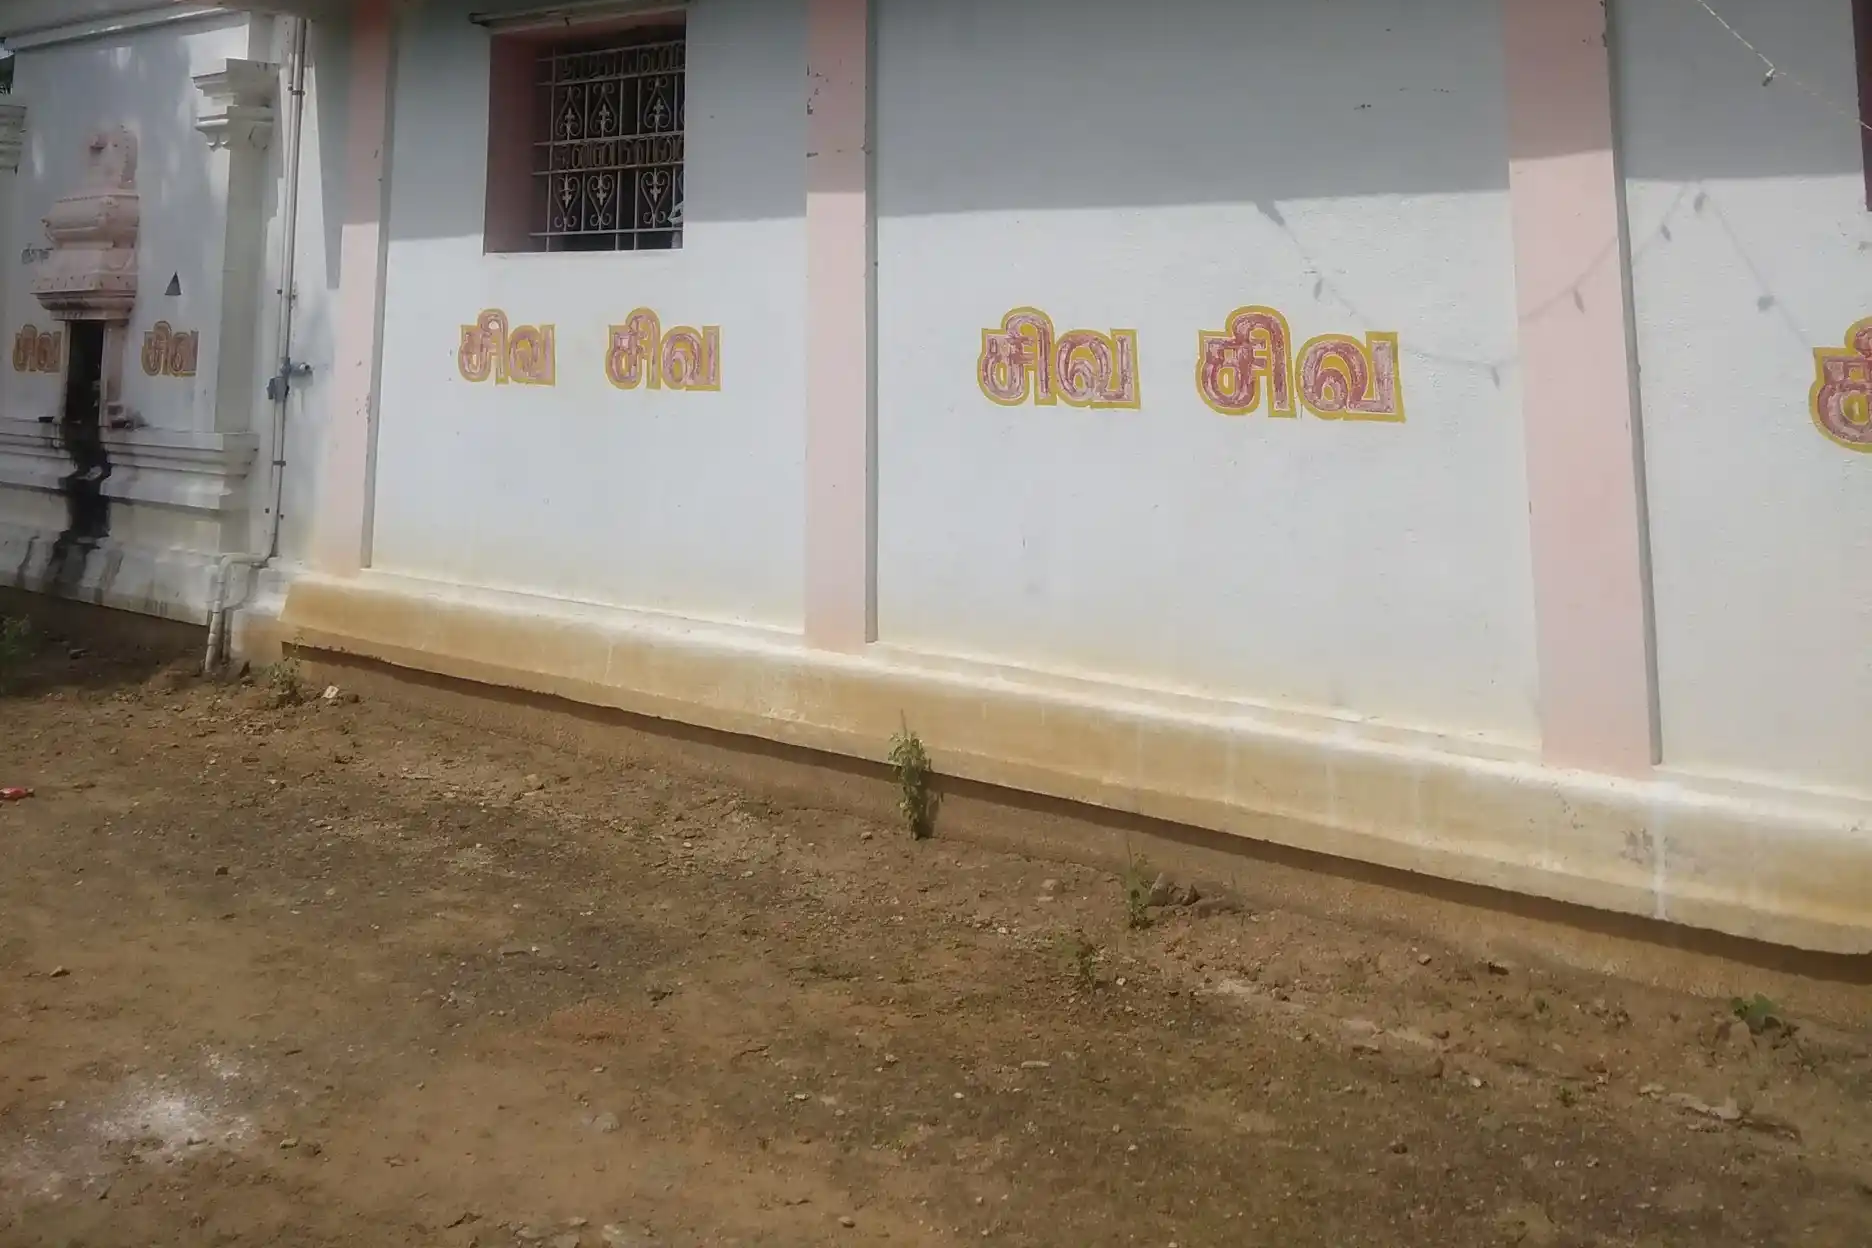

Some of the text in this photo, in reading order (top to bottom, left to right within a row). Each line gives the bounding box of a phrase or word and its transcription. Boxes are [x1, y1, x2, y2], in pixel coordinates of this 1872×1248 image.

[13, 320, 199, 377] சிவ சிவ
[457, 306, 721, 391] சிவ சிவ
[977, 304, 1407, 423] சிவ சிவ
